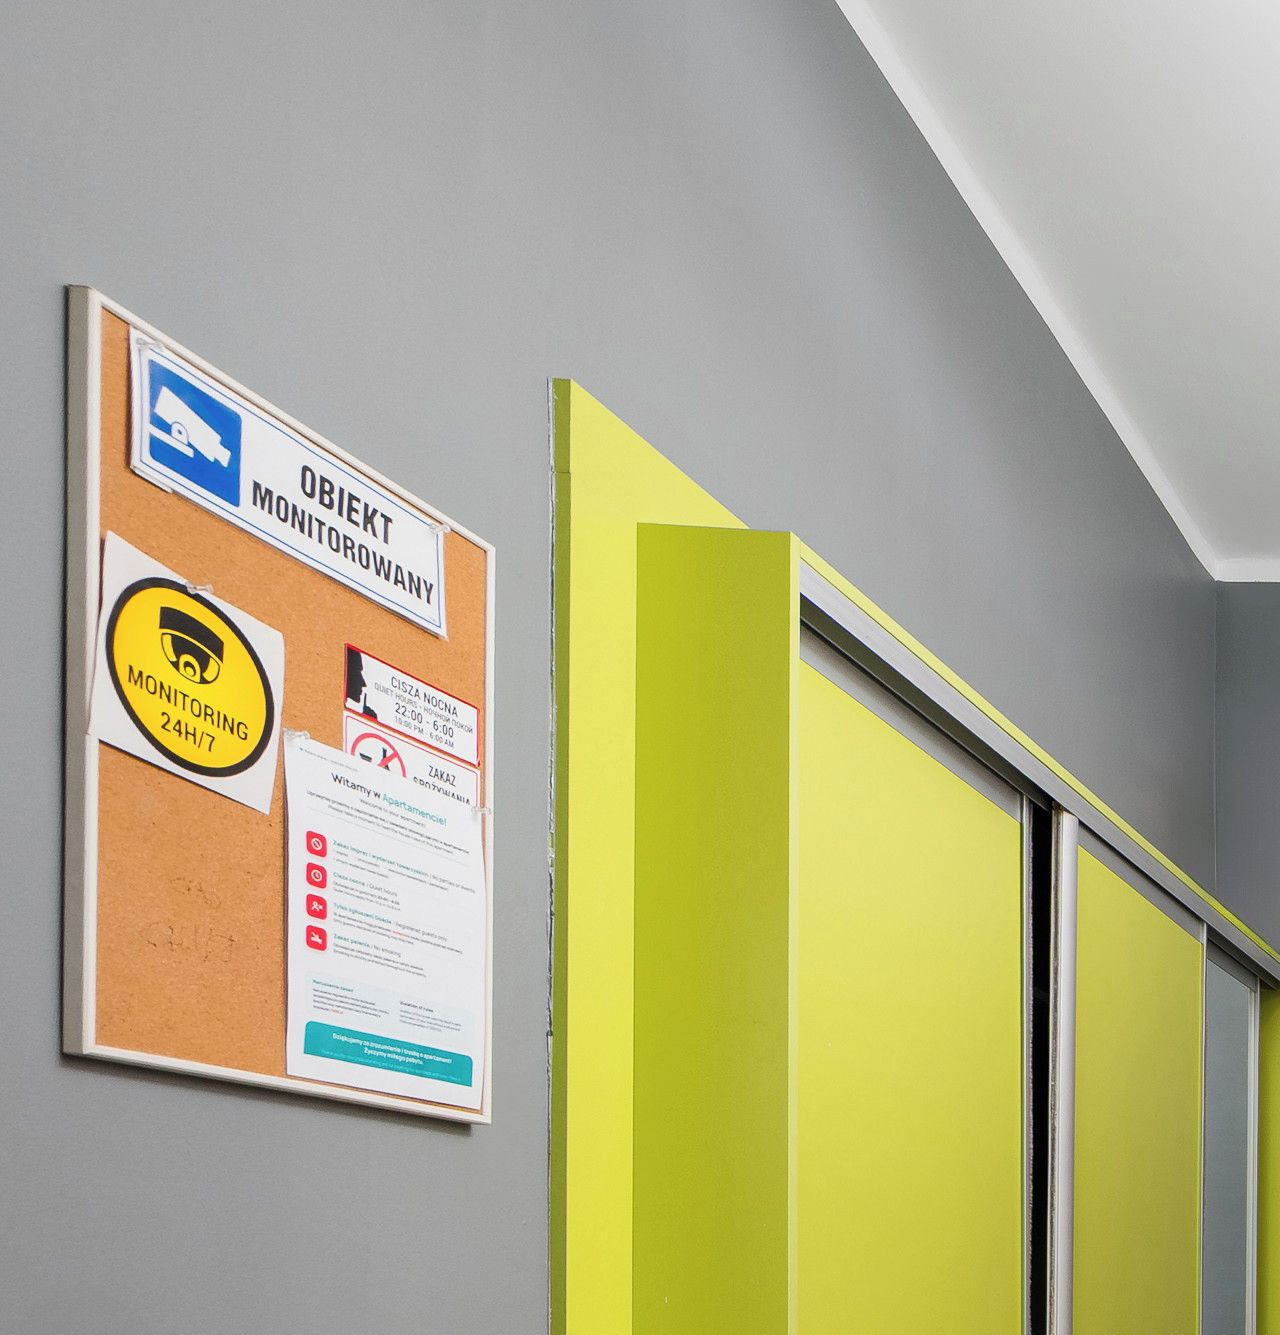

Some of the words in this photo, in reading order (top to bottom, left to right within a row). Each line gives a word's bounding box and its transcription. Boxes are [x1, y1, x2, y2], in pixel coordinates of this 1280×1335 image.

[300, 464, 394, 546] OBIEKT
[252, 480, 435, 606] MONITOROWANY
[127, 665, 249, 742] MONITORING
[374, 682, 393, 697] QUIET
[396, 693, 418, 708] HOURS
[391, 676, 420, 700] CISZA
[423, 692, 458, 717] NOCNA
[160, 711, 216, 753] 24H/7
[394, 703, 423, 723] 22:00
[433, 721, 454, 738] 6:00
[413, 725, 424, 735] PM
[444, 737, 454, 748] AM
[428, 765, 457, 787] ZAKAZ
[331, 771, 370, 798] Witamy
[373, 790, 381, 799] w
[382, 792, 446, 827] Apartamencie!
